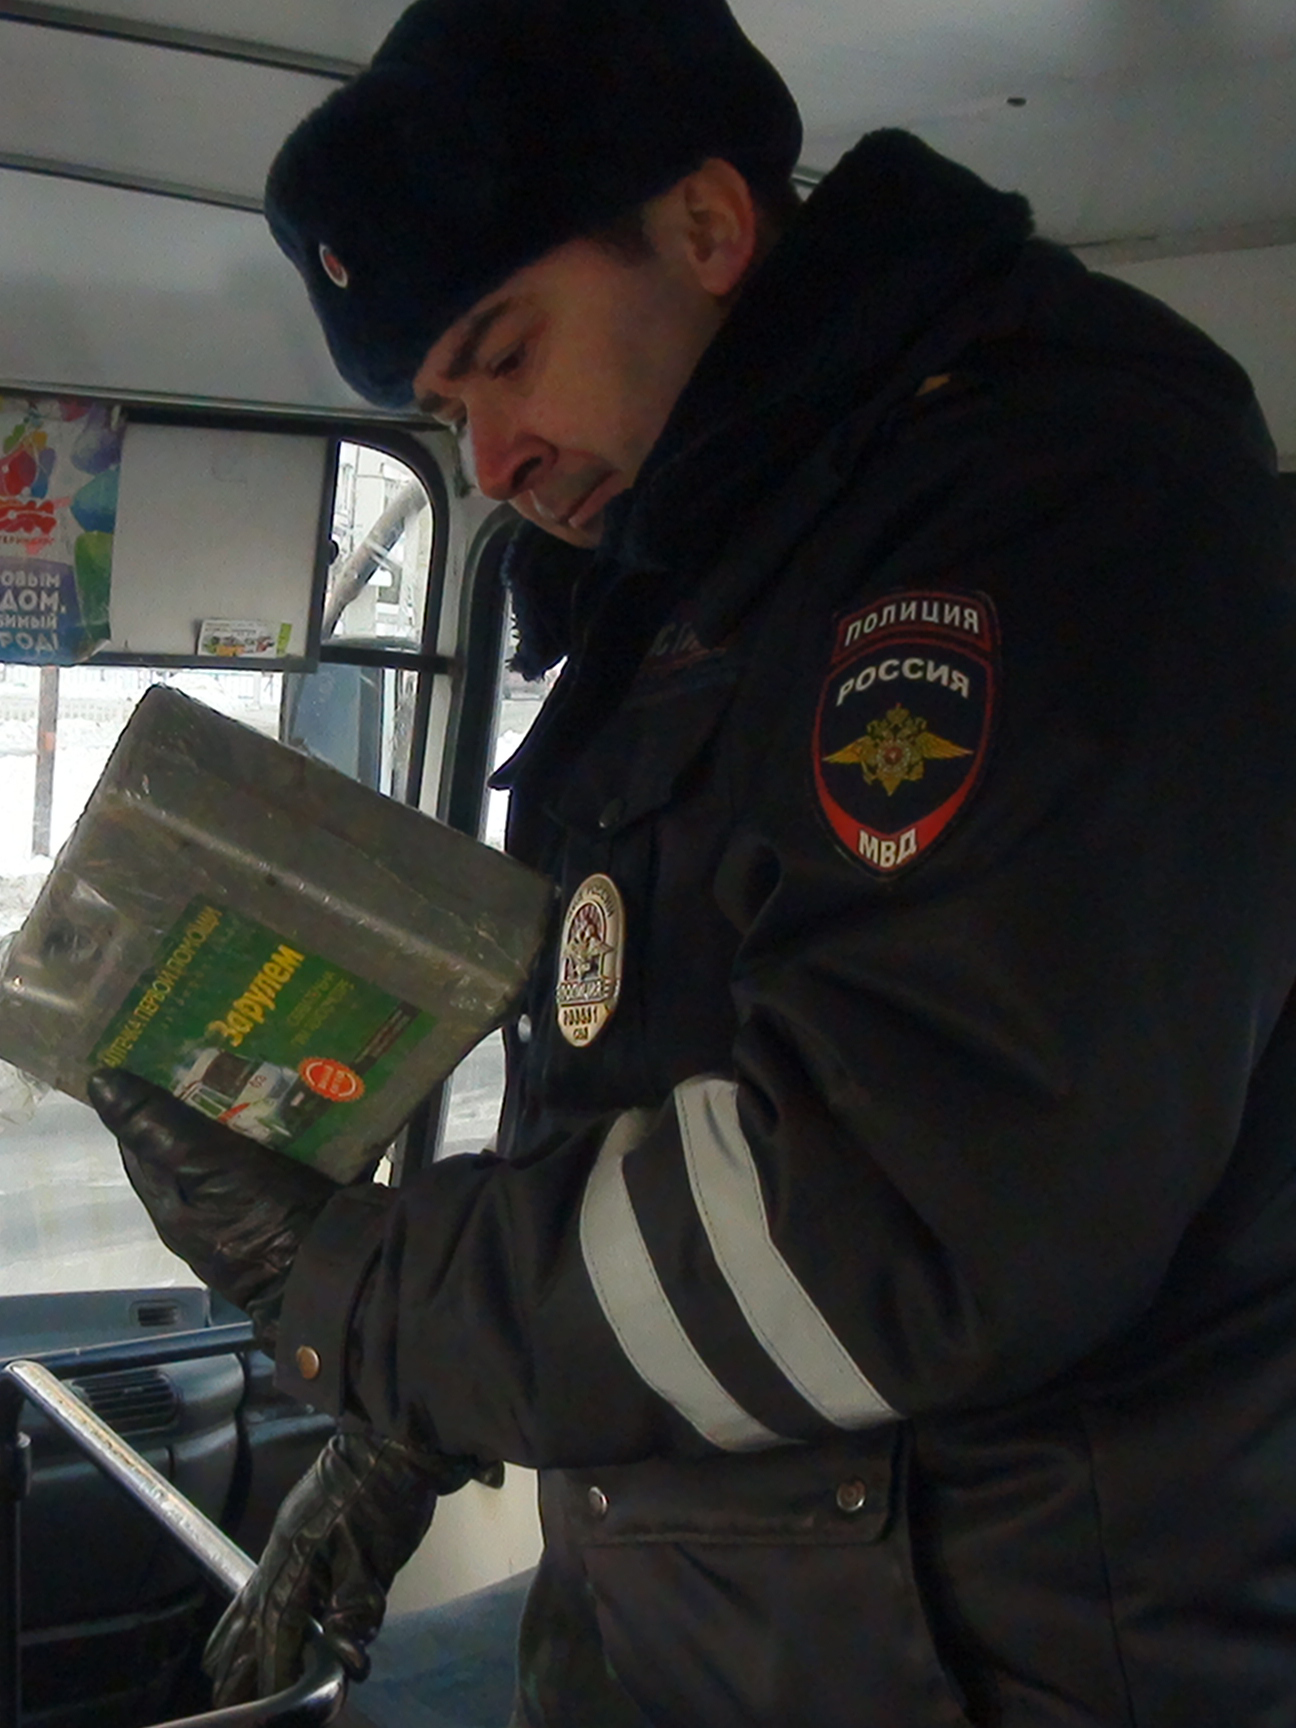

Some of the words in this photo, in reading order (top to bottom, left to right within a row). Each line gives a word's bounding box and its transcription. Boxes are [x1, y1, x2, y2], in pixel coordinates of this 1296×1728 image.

[845, 601, 979, 647] ПОЛИЦИЯ
[835, 657, 970, 707] РОССИЯ
[858, 828, 918, 868] МВД
